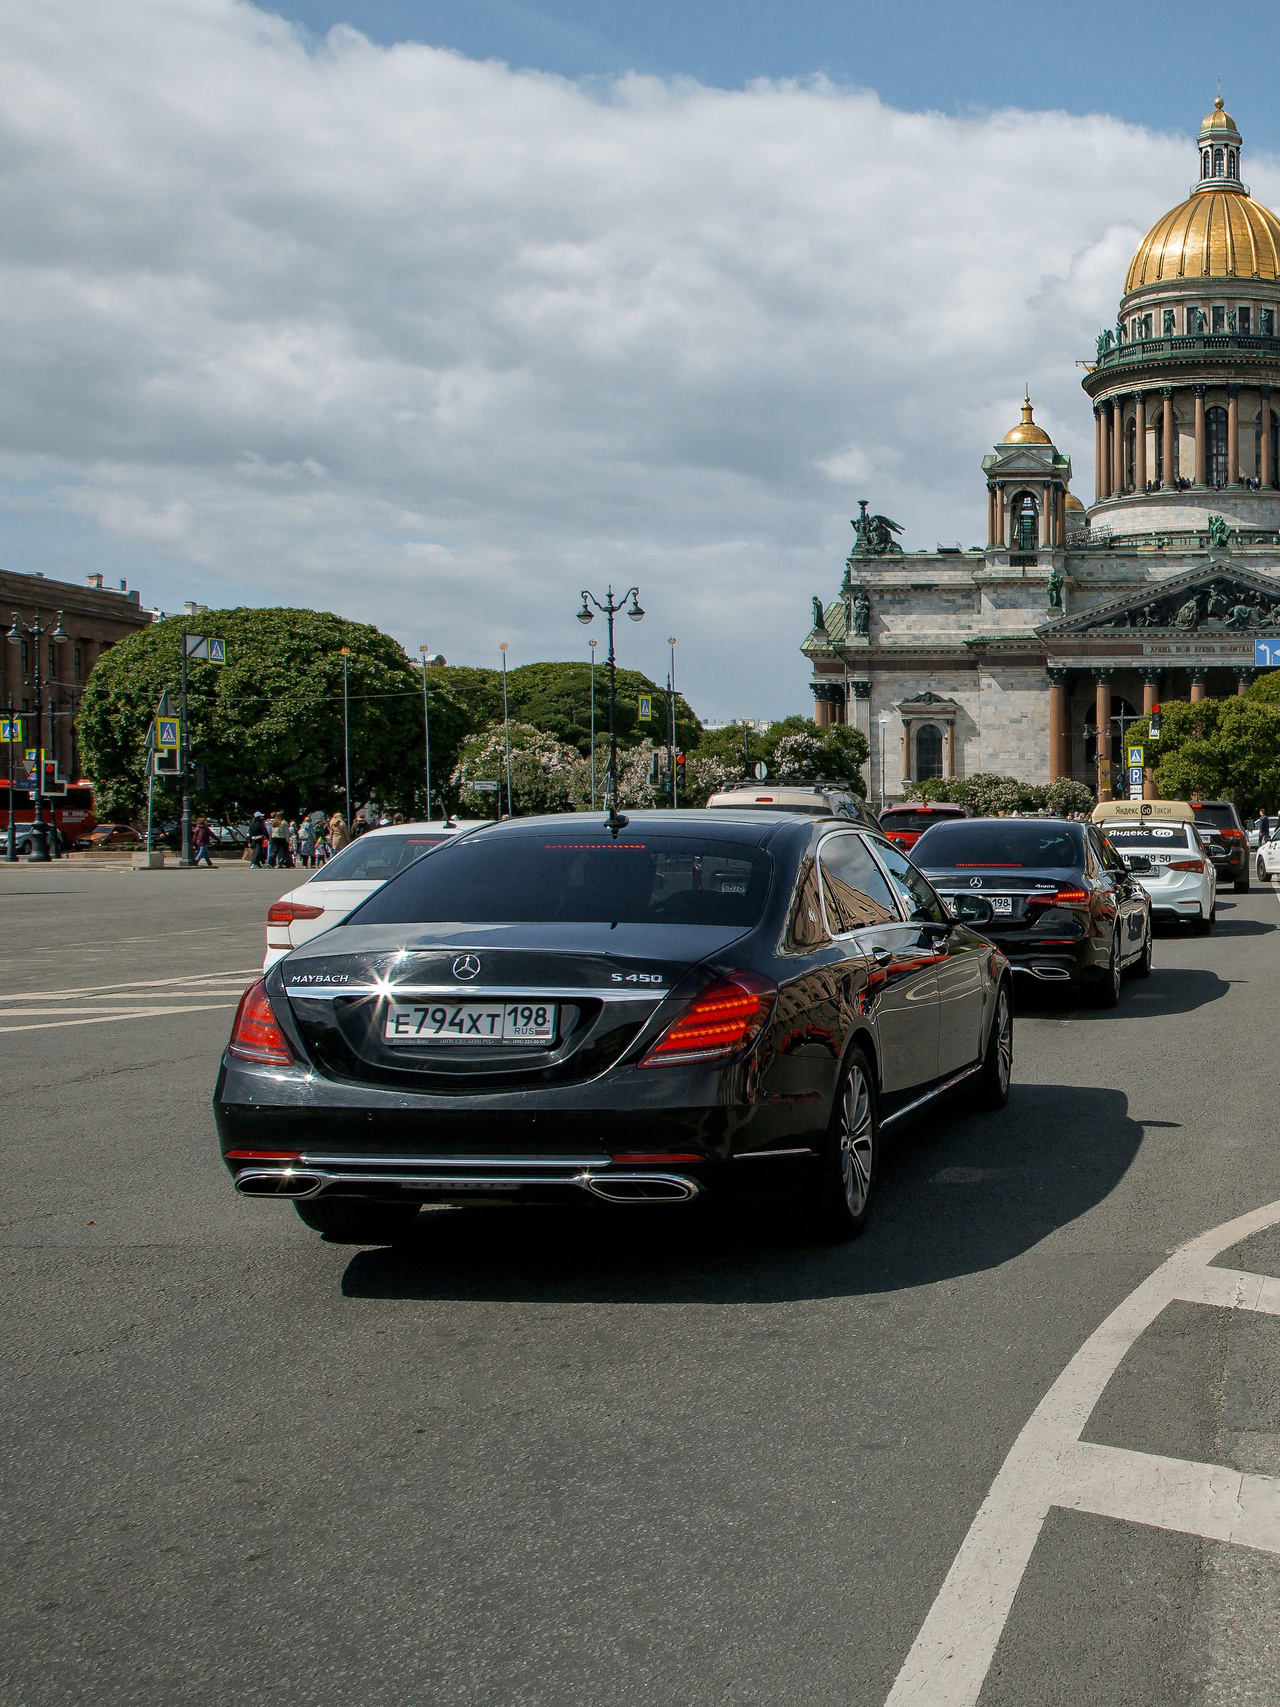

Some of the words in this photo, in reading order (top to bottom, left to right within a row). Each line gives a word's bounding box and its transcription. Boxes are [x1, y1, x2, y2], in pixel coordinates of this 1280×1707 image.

[1115, 805, 1139, 815] Яндекс
[1141, 804, 1151, 815] Go
[1153, 805, 1172, 814] Такси
[1108, 829, 1150, 837] Яндекс
[1159, 854, 1171, 862] 50
[992, 898, 1010, 907] 198
[291, 974, 349, 983] MAYBACH
[611, 973, 623, 982] S
[625, 973, 663, 983] 450
[507, 1006, 547, 1027] 198
[514, 1027, 535, 1035] RUS
